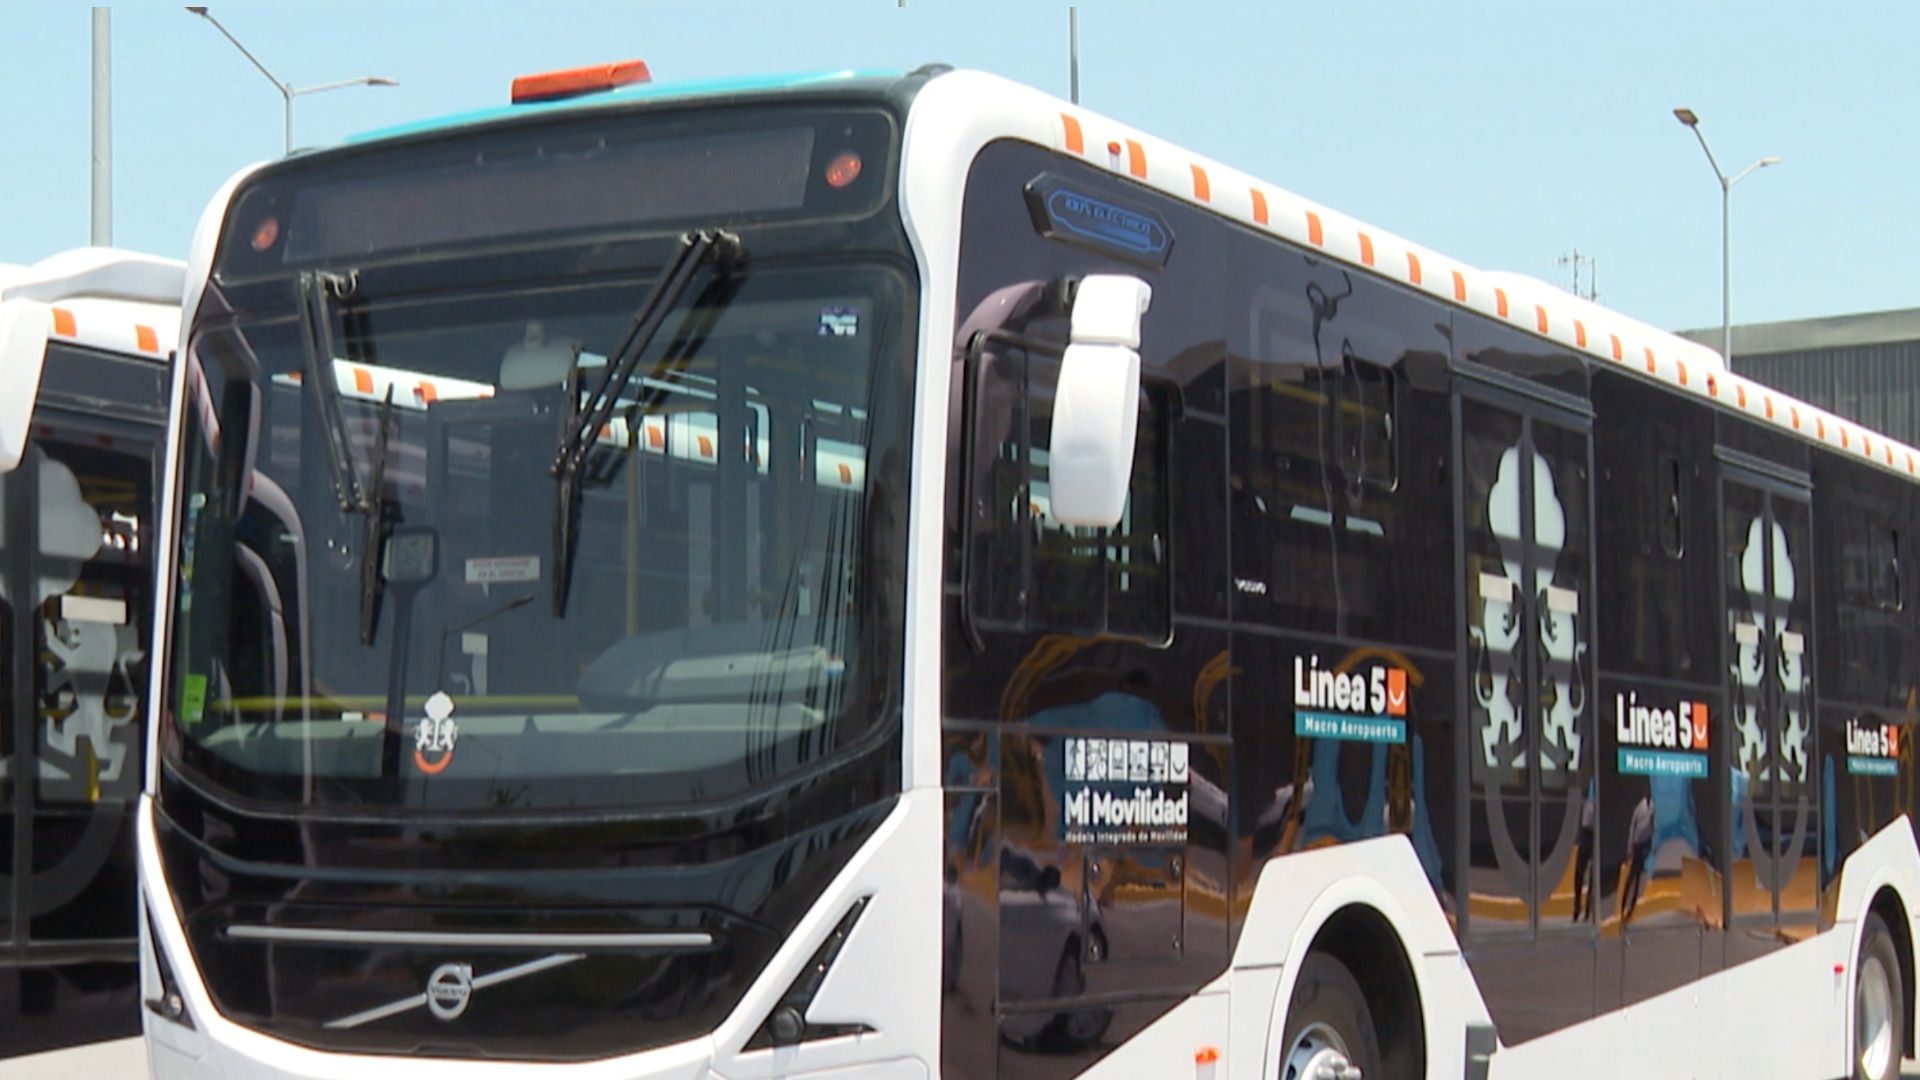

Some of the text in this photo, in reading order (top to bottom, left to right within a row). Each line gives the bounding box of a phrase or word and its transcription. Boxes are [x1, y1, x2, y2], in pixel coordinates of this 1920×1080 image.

[1294, 654, 1387, 715] Línea 5
[1305, 716, 1398, 740] Macro Aeropuerto
[1617, 690, 1692, 750] Línea 5
[1846, 717, 1889, 757] Línea 5
[1625, 753, 1654, 771] Macro
[1064, 785, 1188, 827] Mi Movilidad
